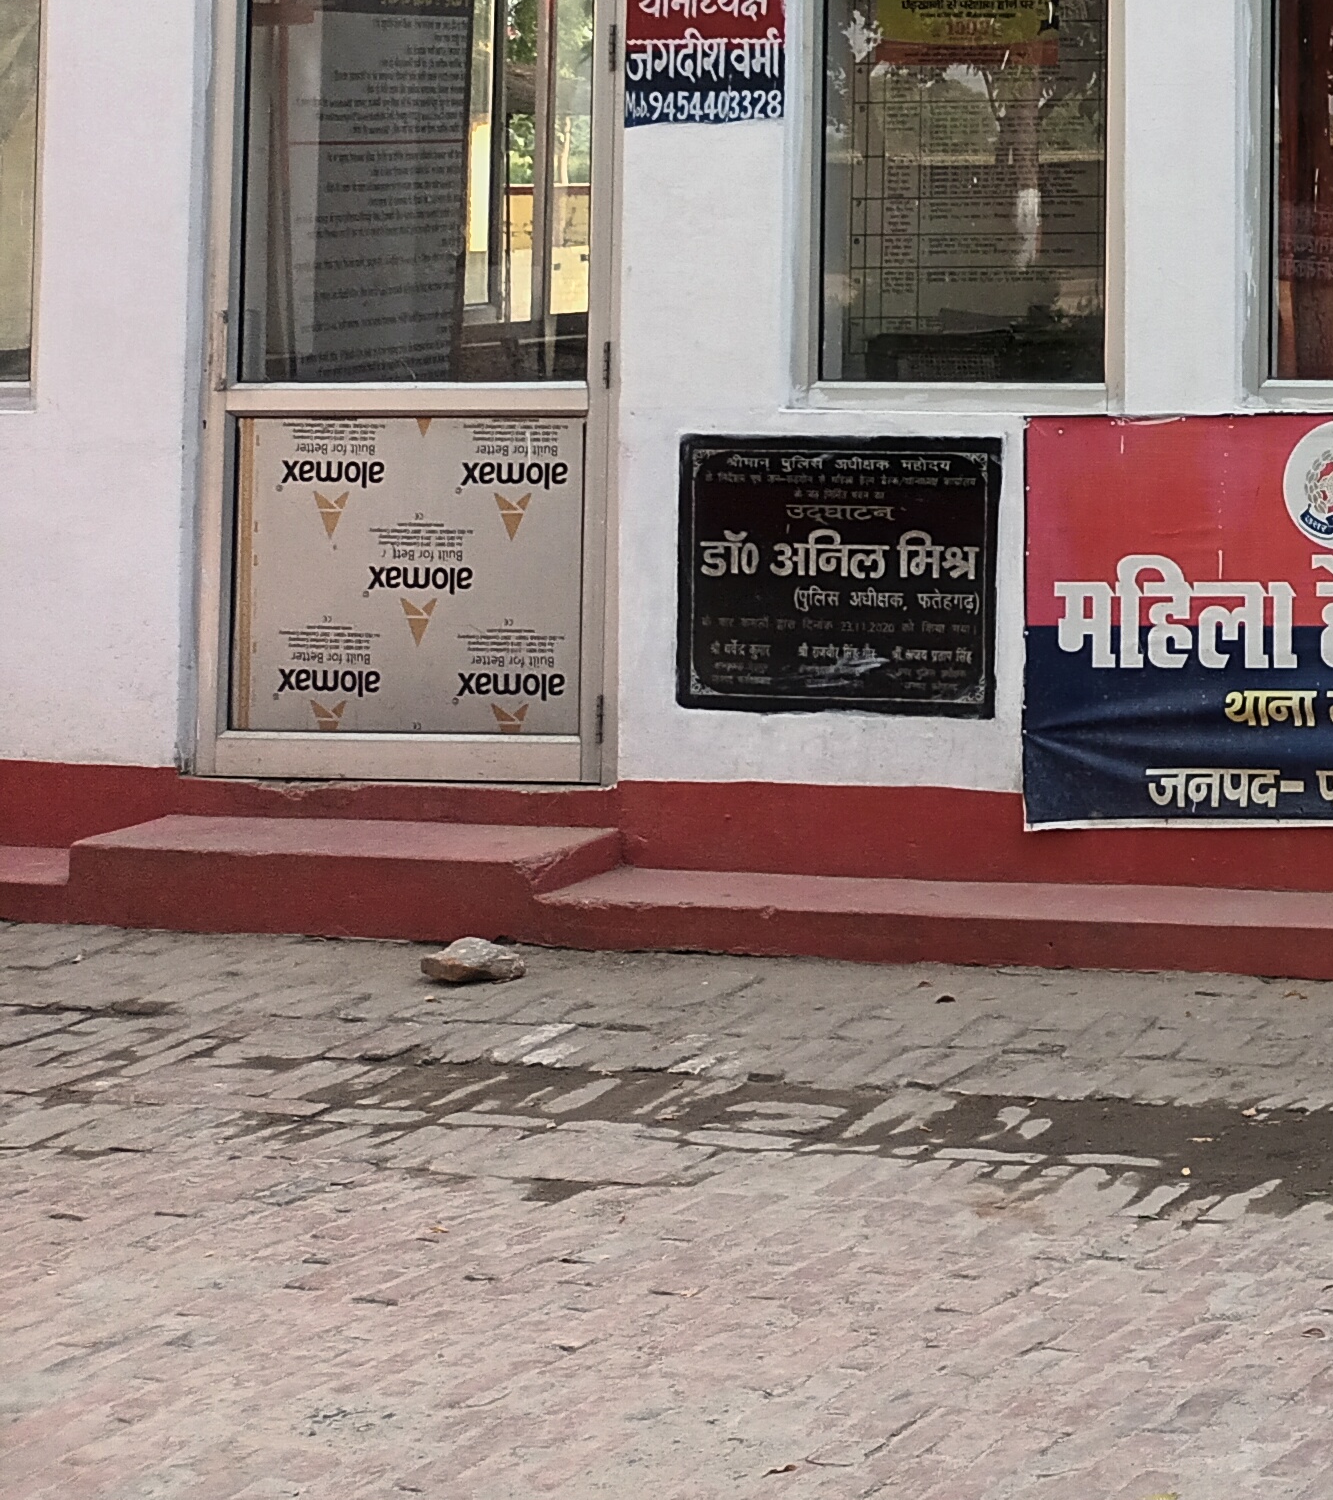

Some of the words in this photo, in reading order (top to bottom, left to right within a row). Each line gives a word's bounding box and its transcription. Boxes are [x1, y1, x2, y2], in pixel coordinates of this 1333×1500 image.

[626, 28, 728, 83] जगदीश
[730, 27, 782, 79] वर्मा
[649, 89, 782, 121] 9454403328
[295, 442, 328, 455] Better
[331, 443, 348, 456] for
[350, 443, 376, 456] Built
[475, 443, 509, 456] Better
[281, 459, 386, 488] alomax
[780, 455, 823, 472] पुलिस
[835, 455, 890, 471] अधीक्षक
[902, 458, 951, 472] महोदय
[461, 461, 568, 489] alomax
[418, 549, 434, 561] for
[438, 549, 463, 561] Built
[769, 528, 890, 579] अनिल
[897, 529, 980, 580] मिश्र
[368, 566, 474, 595] alomax
[794, 586, 840, 612] (पुलिस
[849, 588, 908, 611] अधीक्षक,
[917, 590, 980, 615] फतेहगढ़)
[1053, 554, 1297, 669] महिला
[291, 651, 324, 664] Better
[471, 654, 505, 667] Better
[509, 655, 525, 668] for
[528, 655, 555, 668] Built
[278, 668, 380, 698] alomax
[457, 672, 565, 701] alomax
[1224, 688, 1315, 729] थाना
